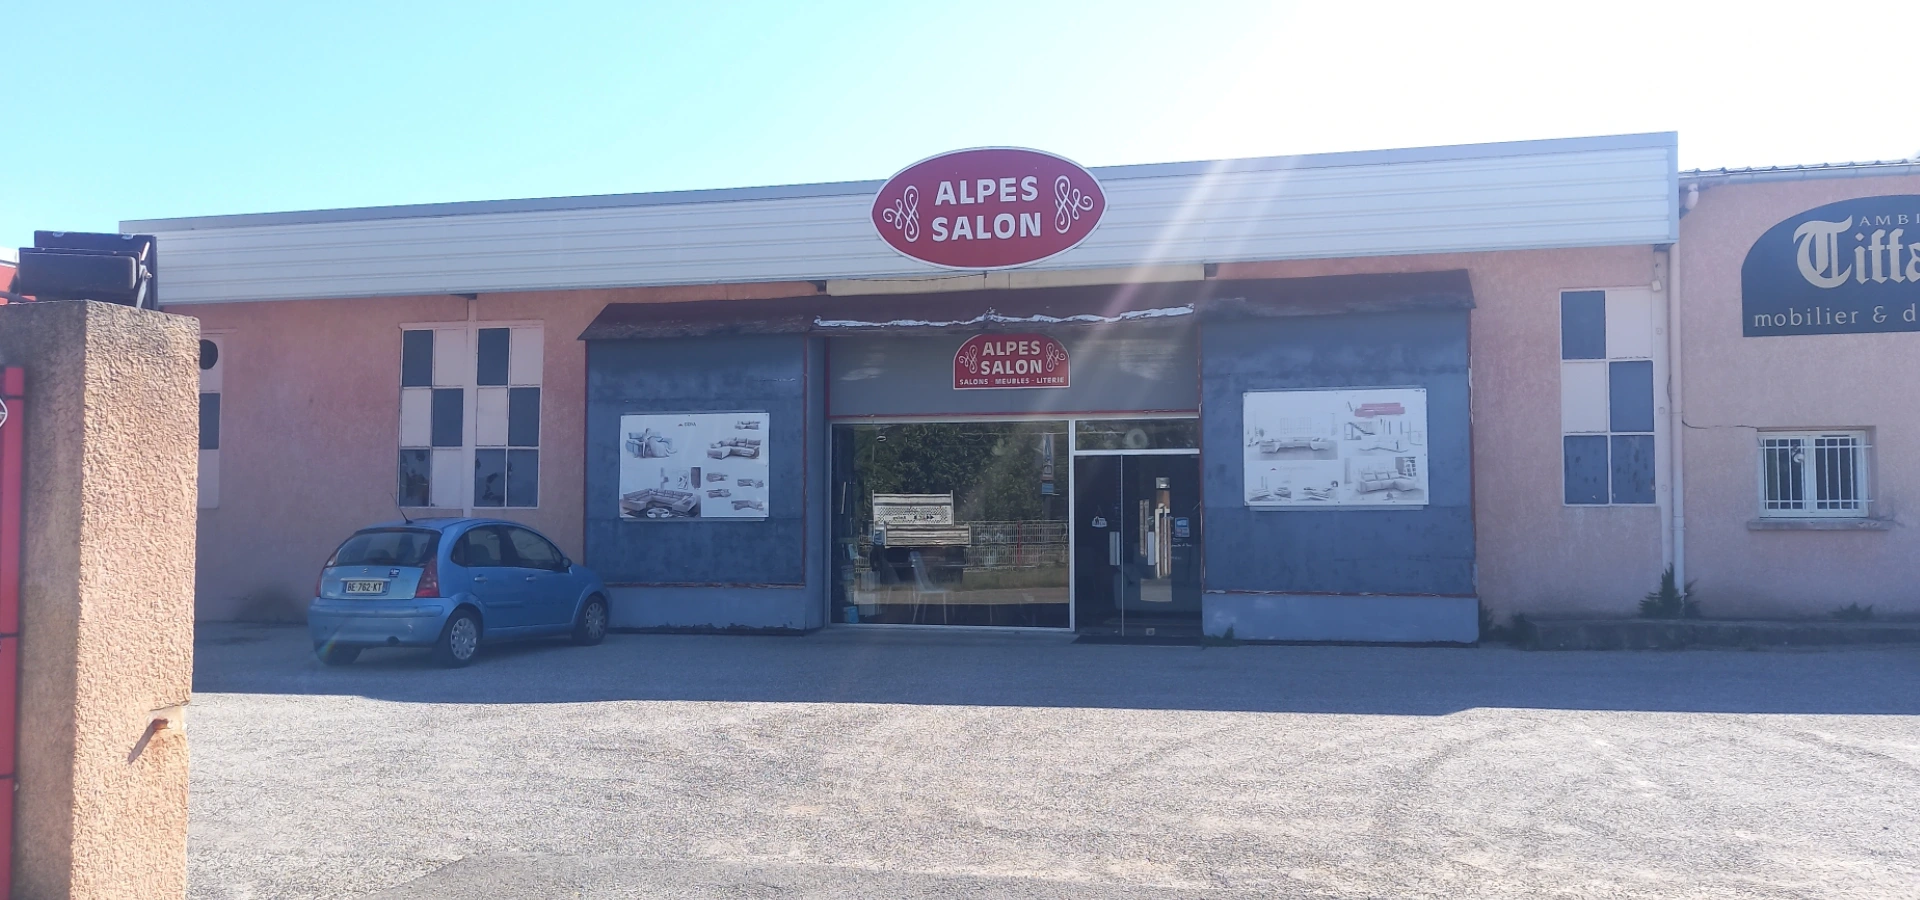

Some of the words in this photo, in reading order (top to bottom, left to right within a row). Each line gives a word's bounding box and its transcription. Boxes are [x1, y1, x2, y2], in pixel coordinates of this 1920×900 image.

[935, 176, 1039, 206] ALPES
[932, 212, 1041, 242] SALON
[1754, 306, 1859, 327] mobilier
[1872, 305, 1888, 323] &
[982, 341, 1041, 356] ALPES
[980, 360, 1042, 375] SALON
[995, 377, 1030, 385] MEUBLES
[1036, 376, 1065, 384] LITERIE
